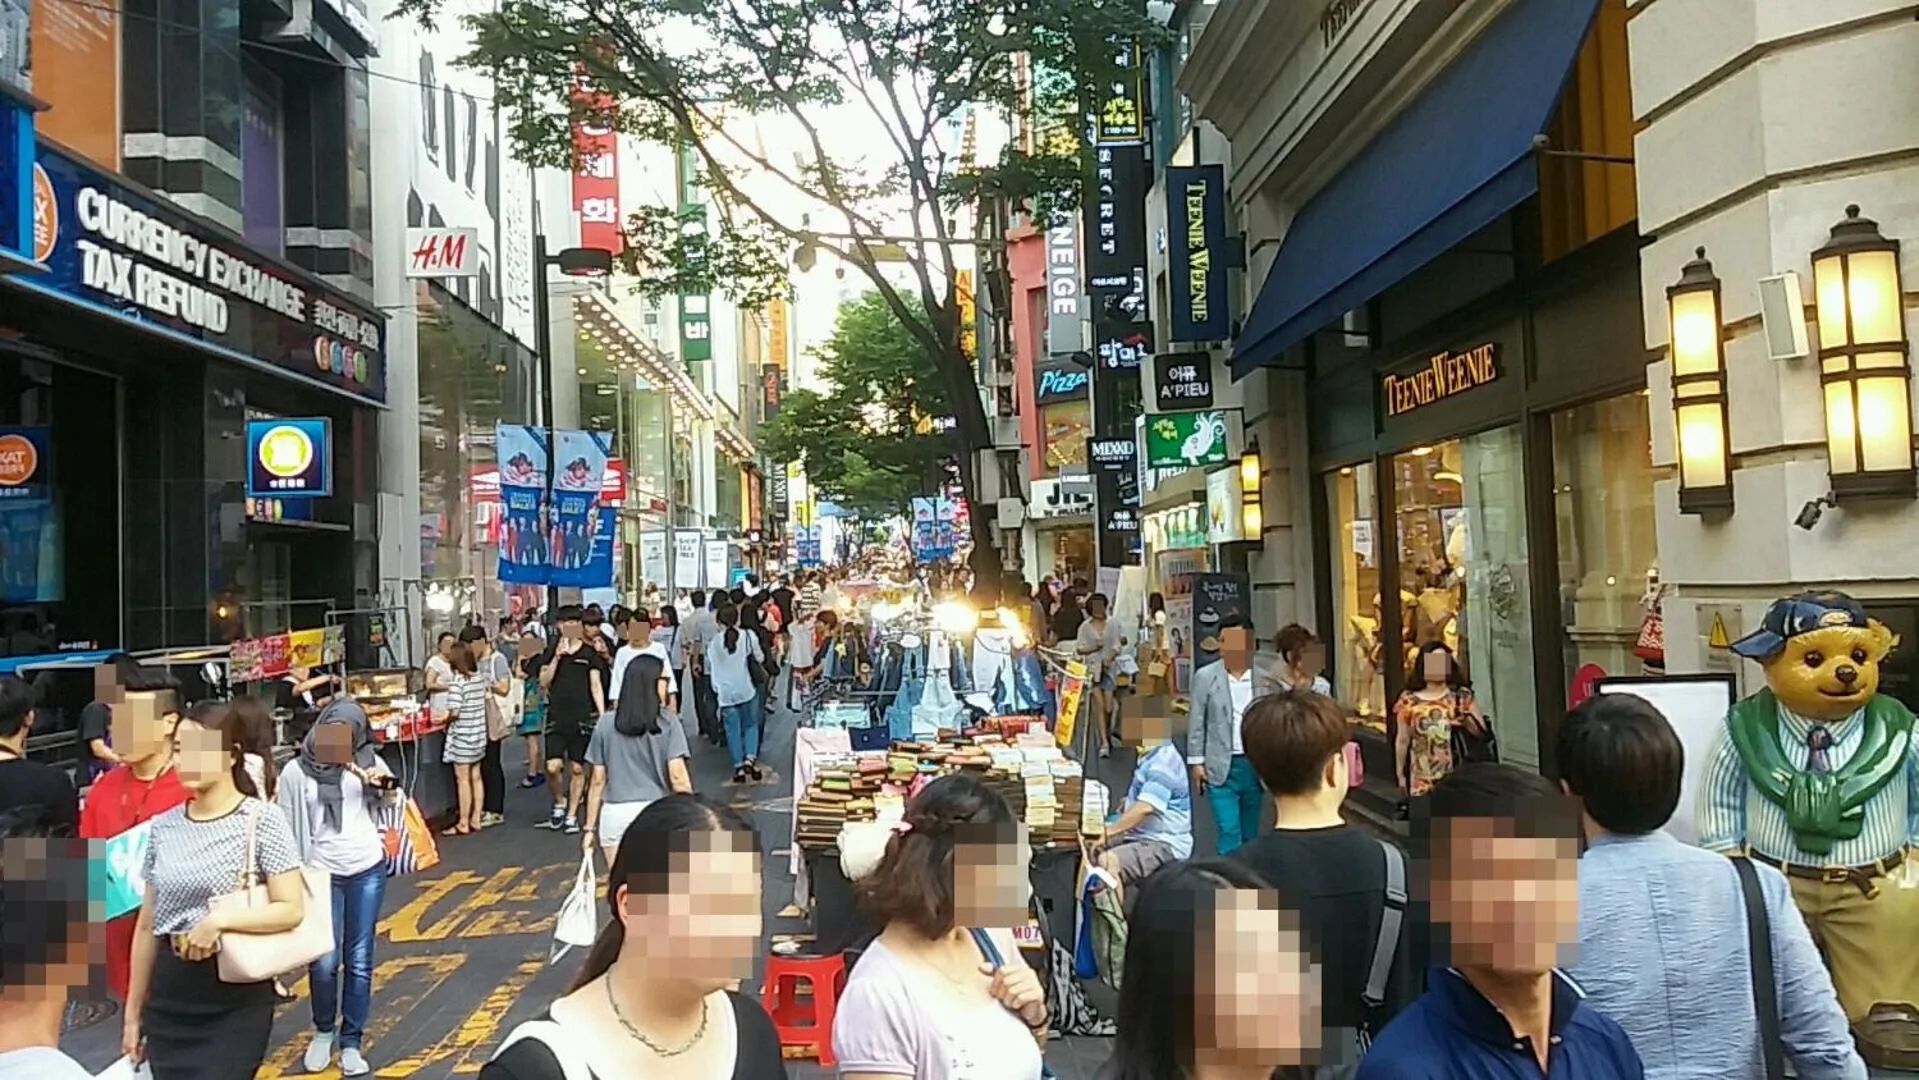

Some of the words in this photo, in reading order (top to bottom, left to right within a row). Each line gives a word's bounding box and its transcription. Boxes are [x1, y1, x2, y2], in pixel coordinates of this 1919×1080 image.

[1098, 148, 1115, 255] SECRET
[76, 238, 134, 301] TAX
[134, 263, 230, 335] REFUND
[77, 186, 208, 279] CURRENCY
[209, 247, 307, 323] EXCHANGE
[1037, 368, 1088, 400] Pizza
[1160, 382, 1210, 399] A'PIEU
